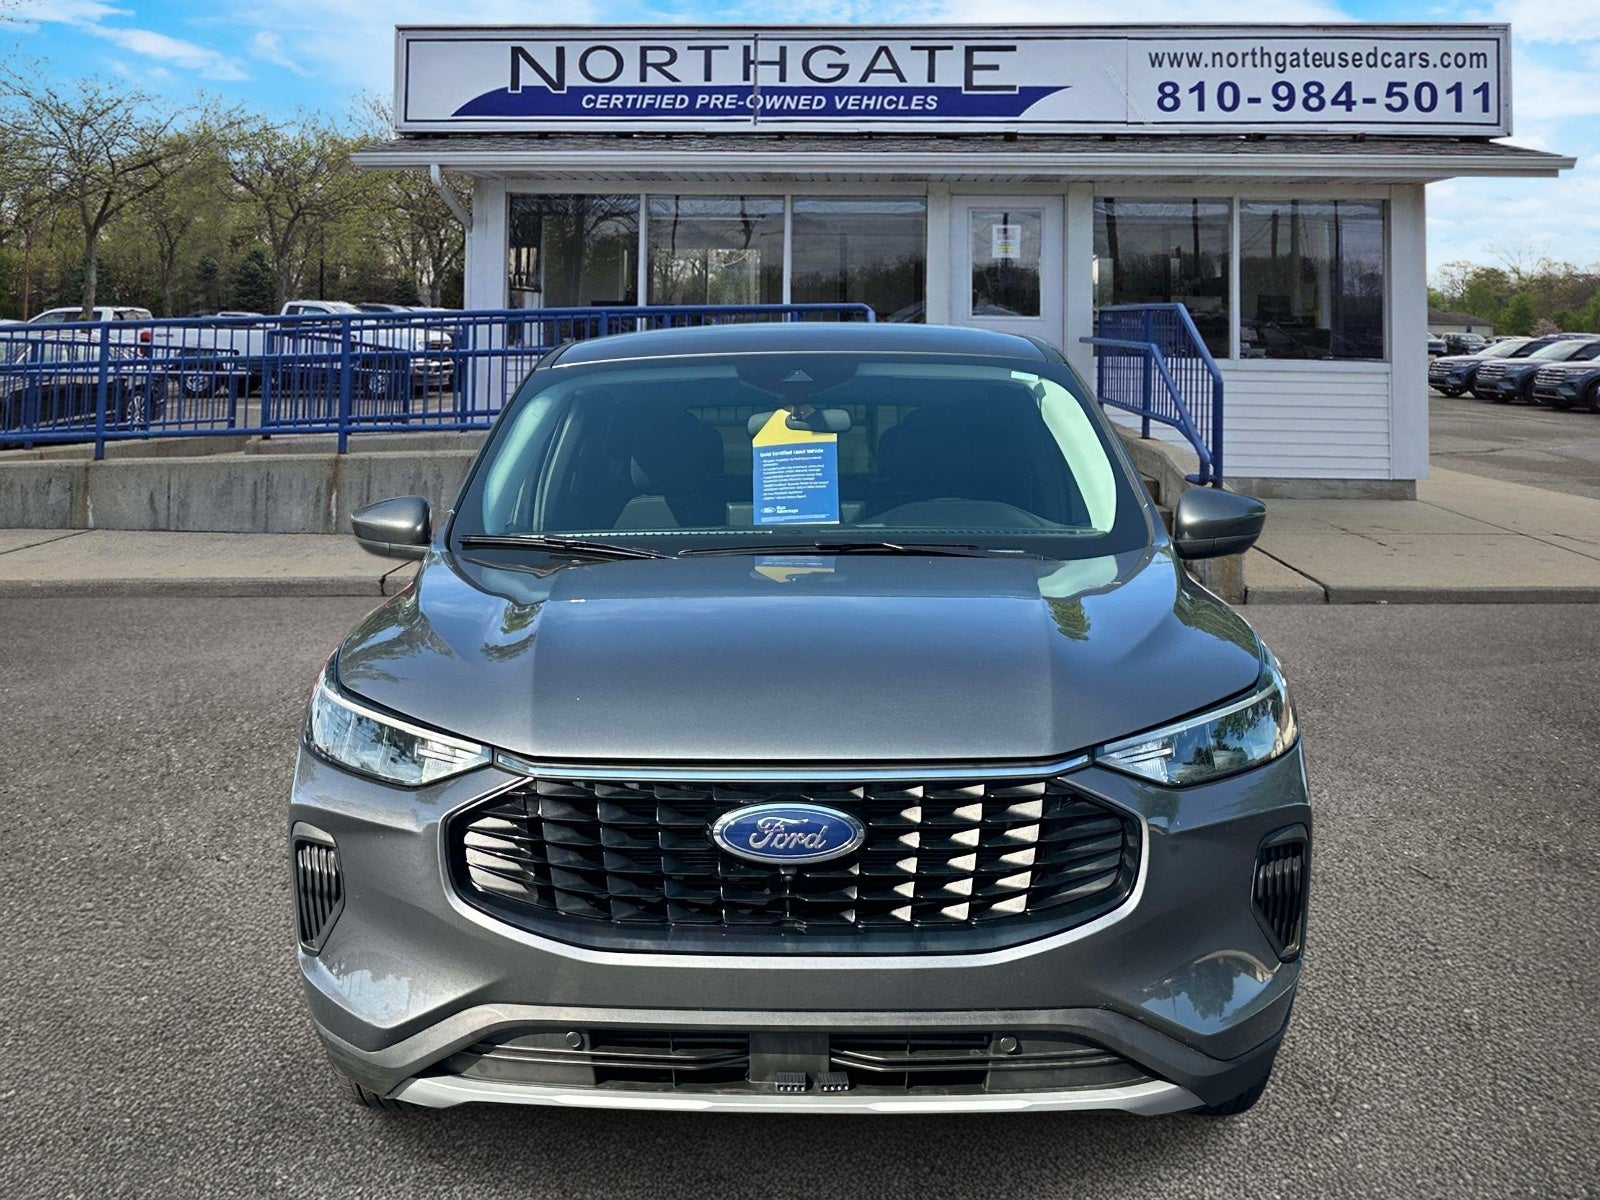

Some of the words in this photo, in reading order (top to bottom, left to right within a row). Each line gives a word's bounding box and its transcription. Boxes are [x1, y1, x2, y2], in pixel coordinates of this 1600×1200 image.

[510, 44, 1017, 92] NORTHGATE
[1149, 46, 1488, 74] www.northgateusedcars.com
[581, 94, 689, 110] CERTIFIED
[695, 94, 827, 110] PRE-OWNED
[835, 94, 938, 111] VEHICLES
[1156, 80, 1491, 114] 810-984-5011
[749, 816, 829, 849] Ford
